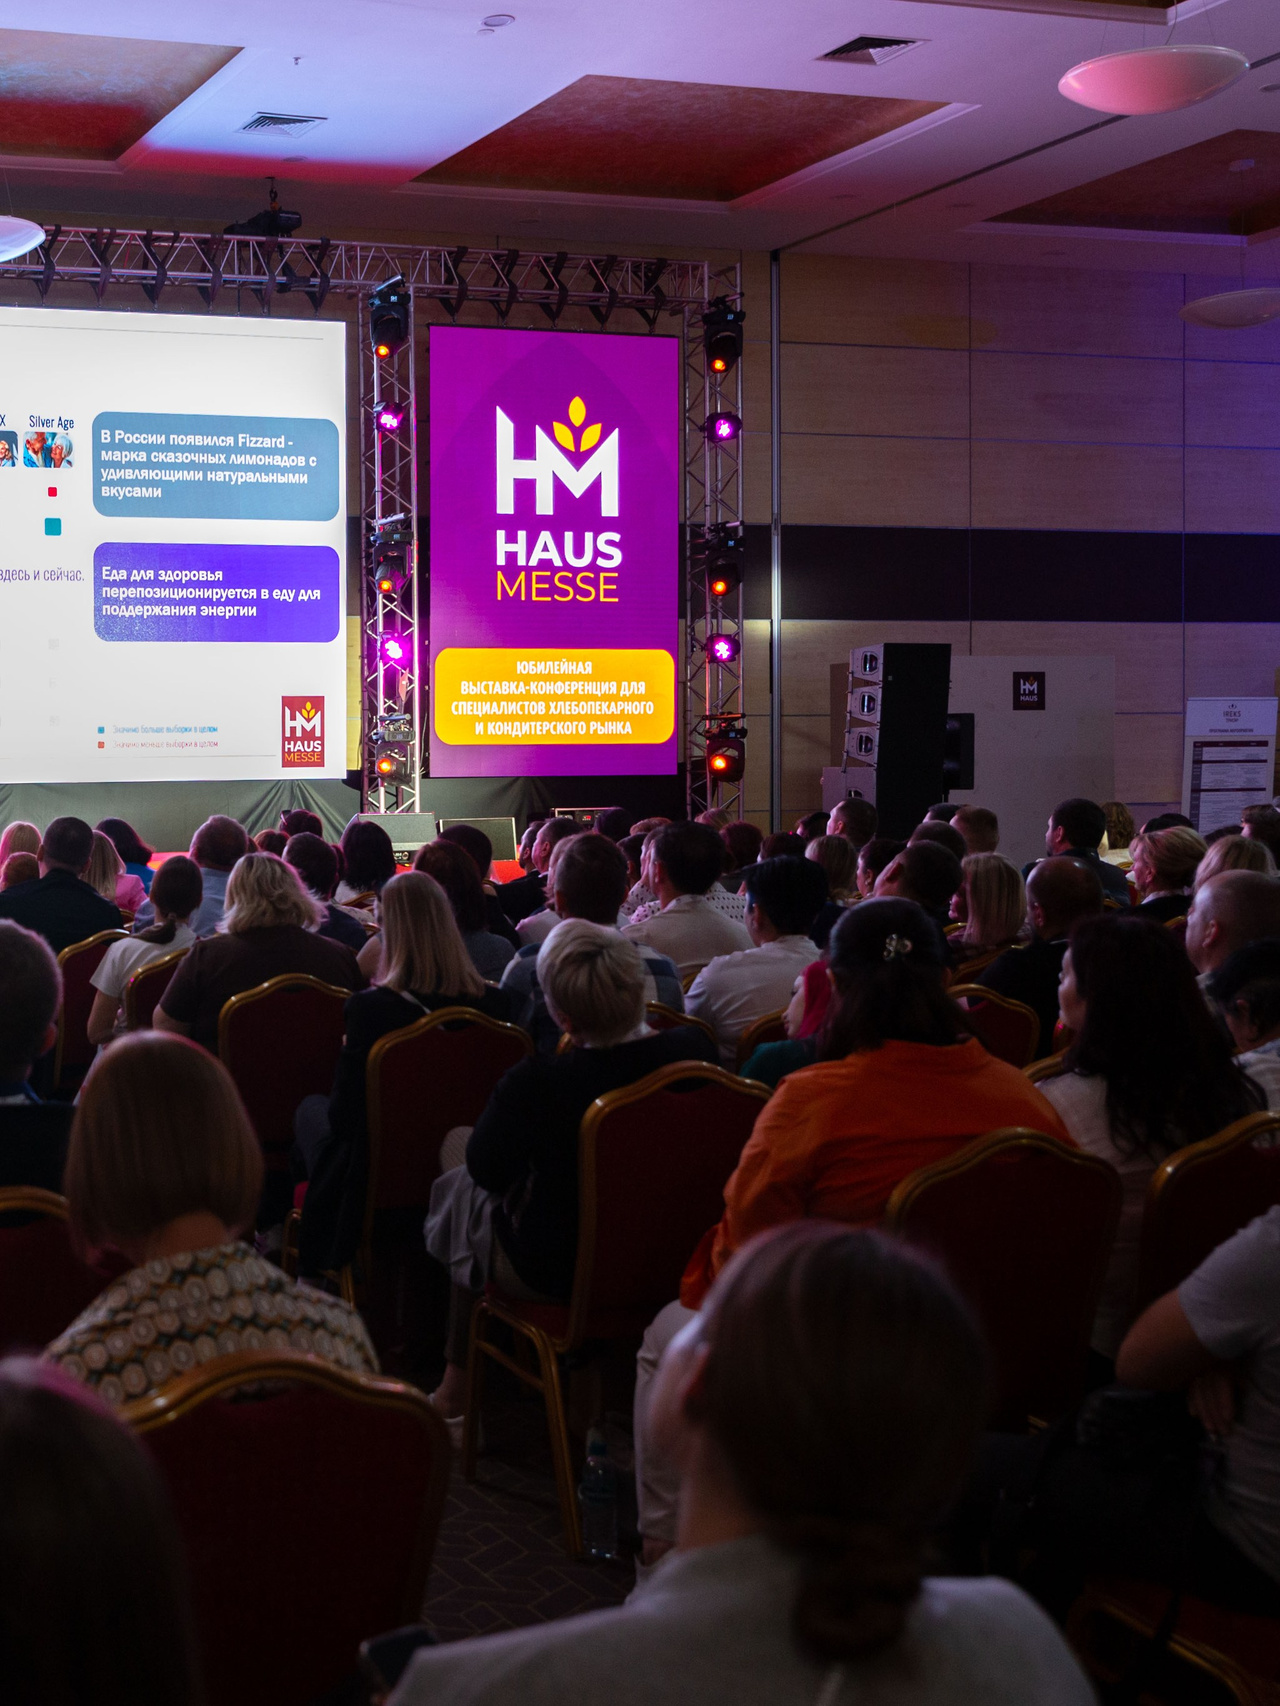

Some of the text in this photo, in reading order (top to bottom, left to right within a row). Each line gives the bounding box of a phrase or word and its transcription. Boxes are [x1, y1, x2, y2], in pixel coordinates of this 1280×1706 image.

[0, 414, 6, 426] X
[29, 415, 74, 430] Silver Age
[101, 430, 110, 443] В
[115, 430, 166, 444] России
[170, 435, 234, 446] появился
[238, 434, 285, 448] Fizzard
[101, 451, 317, 467] марка сказочных лимонадов с
[101, 469, 308, 485] удивляющими натуральными
[101, 486, 162, 499] вкусами
[496, 530, 622, 568] HAUS
[34, 569, 40, 580] и
[43, 568, 85, 581] сейчас.
[102, 567, 223, 583] Еда для здоровья
[496, 571, 619, 602] MESSE
[102, 587, 321, 602] перепозиционируется в еду для
[102, 604, 257, 619] поддержания энергии
[516, 659, 592, 674] ЮБИЛЕЙНАЯ
[461, 681, 645, 697] ВЫСТАВКА-КОНФЕРЕНЦИЯ ДЛЯ
[452, 701, 654, 717] СПЕЦИАЛИСТОВ ХЛЕБОПЕКАРНОГО
[475, 721, 632, 737] И КОНДИТЕРСКОГО РЫНКА
[285, 741, 321, 752] HAUS
[285, 752, 320, 762] MESSE
